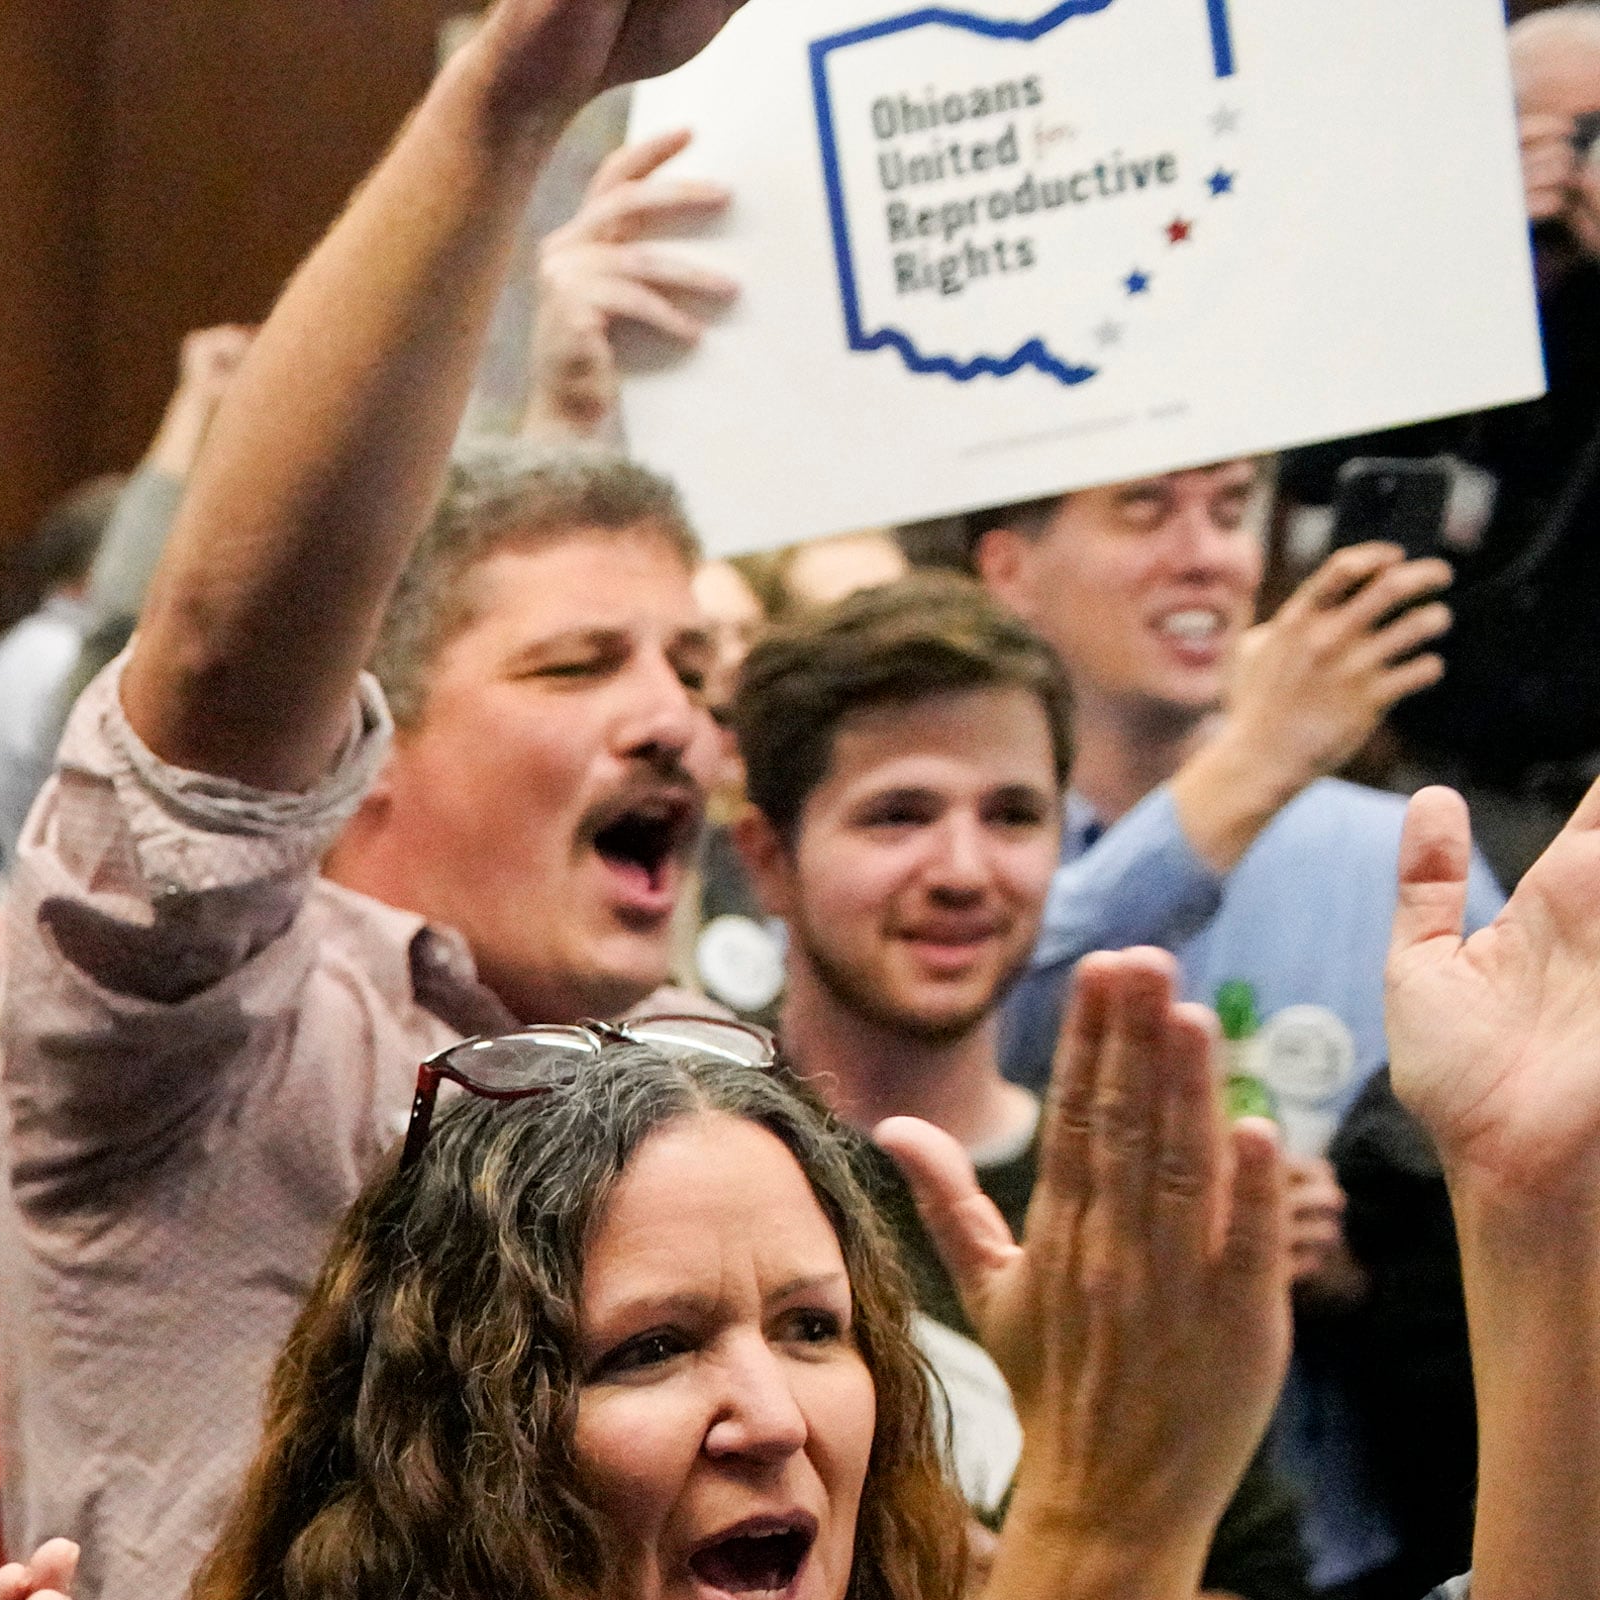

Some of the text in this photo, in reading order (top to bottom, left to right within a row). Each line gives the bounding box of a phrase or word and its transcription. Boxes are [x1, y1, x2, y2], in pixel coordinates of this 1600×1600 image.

[871, 74, 1044, 140] Ohioans
[878, 121, 1019, 191] United
[886, 149, 1178, 243] Reproductive
[894, 236, 1037, 296] Rights
